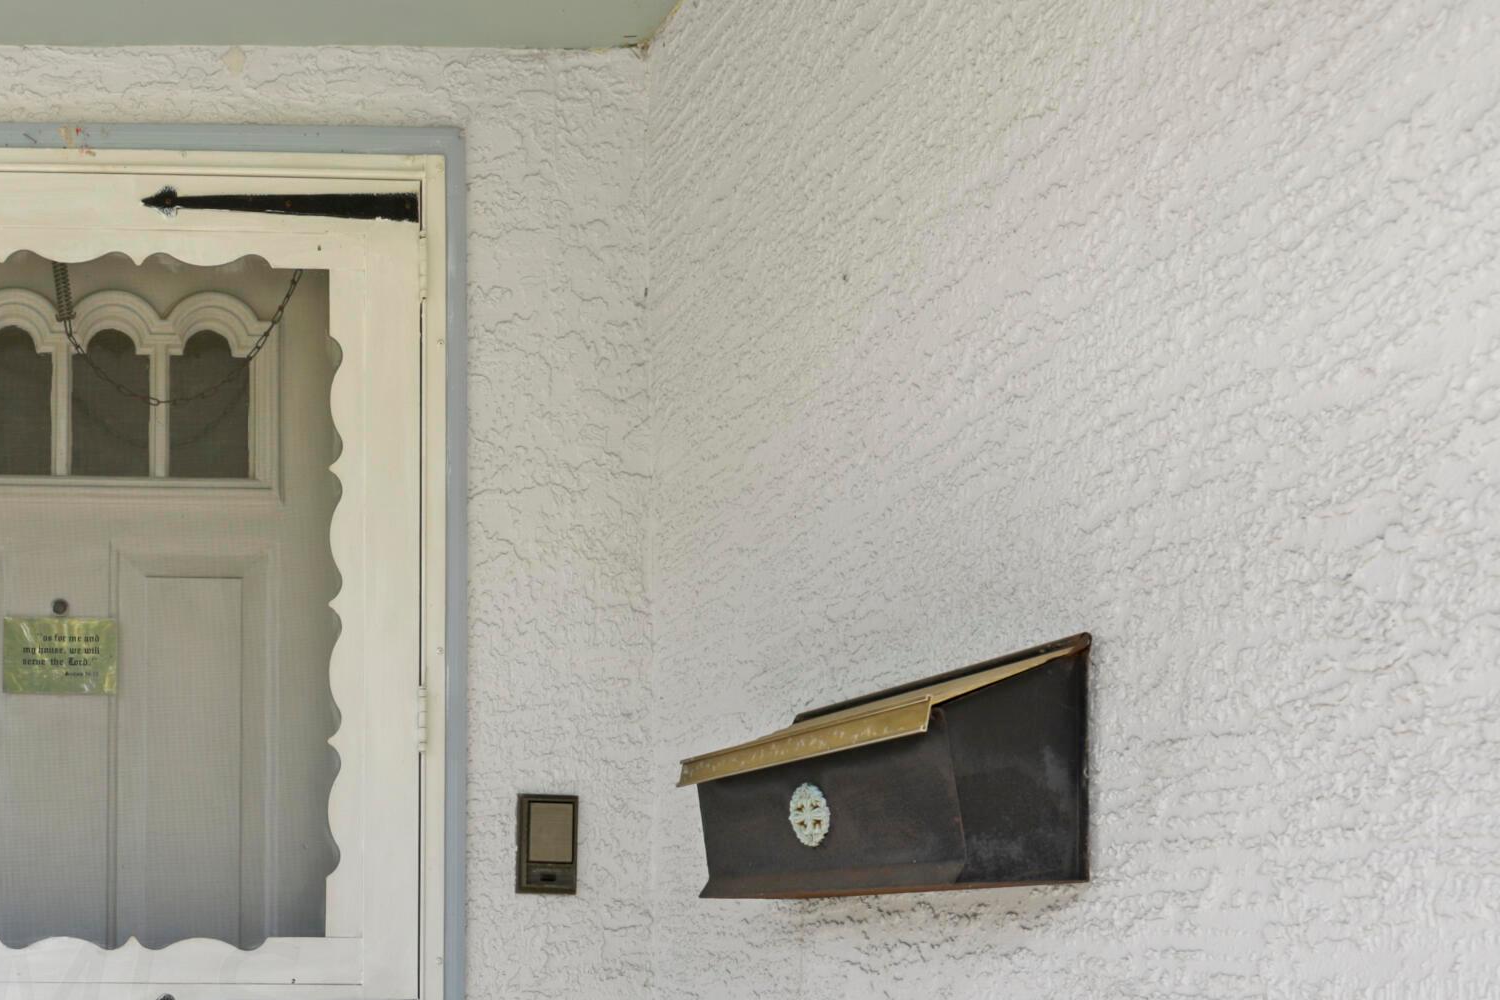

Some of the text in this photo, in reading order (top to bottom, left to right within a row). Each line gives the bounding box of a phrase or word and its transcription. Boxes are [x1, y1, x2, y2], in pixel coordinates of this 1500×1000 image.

[54, 633, 66, 642] for
[68, 635, 82, 643] me
[84, 634, 100, 643] and
[22, 647, 36, 655] my
[84, 646, 100, 655] will
[22, 658, 46, 666] serve
[50, 657, 64, 666] the
